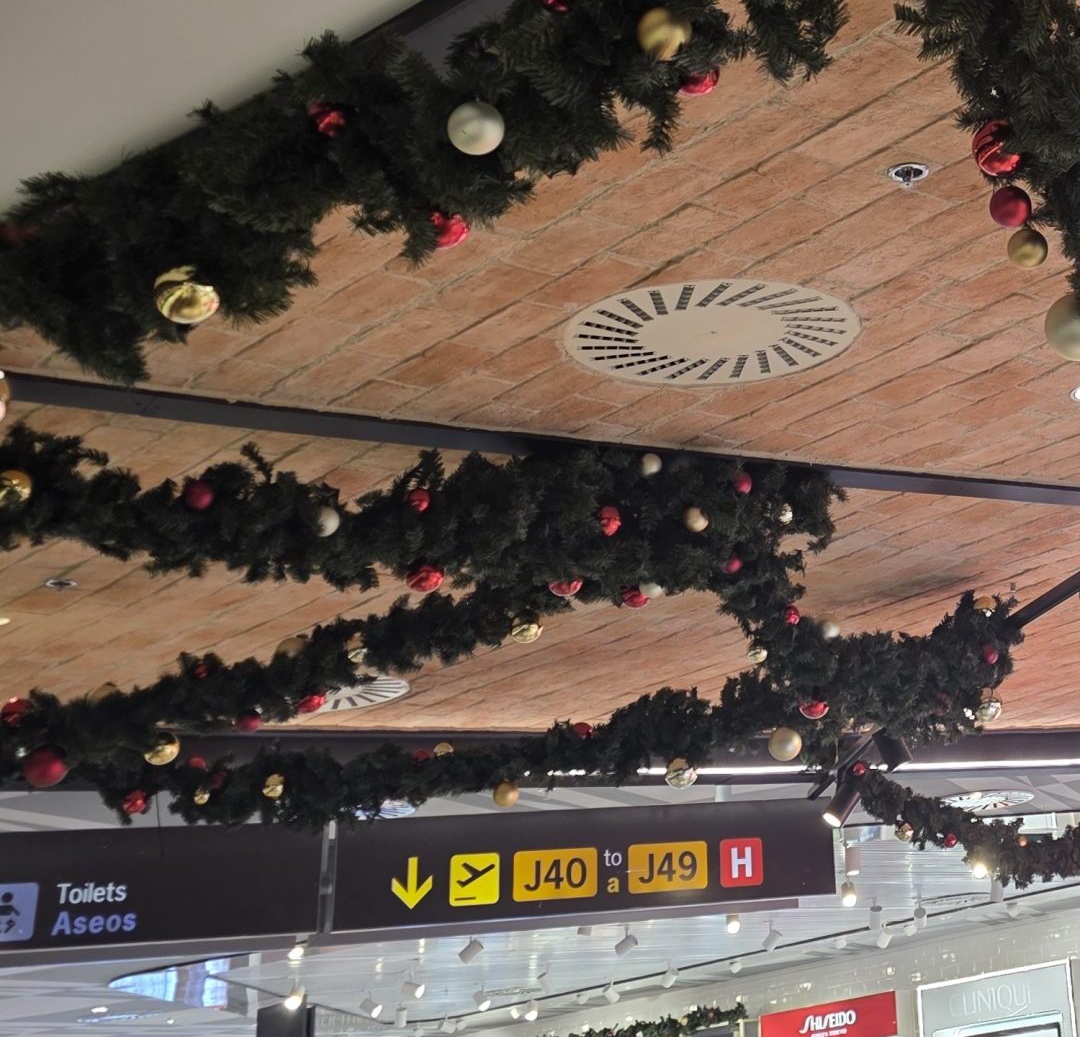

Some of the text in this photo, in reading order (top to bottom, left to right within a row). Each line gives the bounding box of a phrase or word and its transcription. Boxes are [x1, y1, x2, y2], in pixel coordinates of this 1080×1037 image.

[523, 846, 753, 892] J40 to J49 H
[57, 882, 127, 904] Toilets
[606, 876, 620, 893] a
[51, 910, 137, 936] Aseos
[799, 1009, 857, 1034] SHISEIDO
